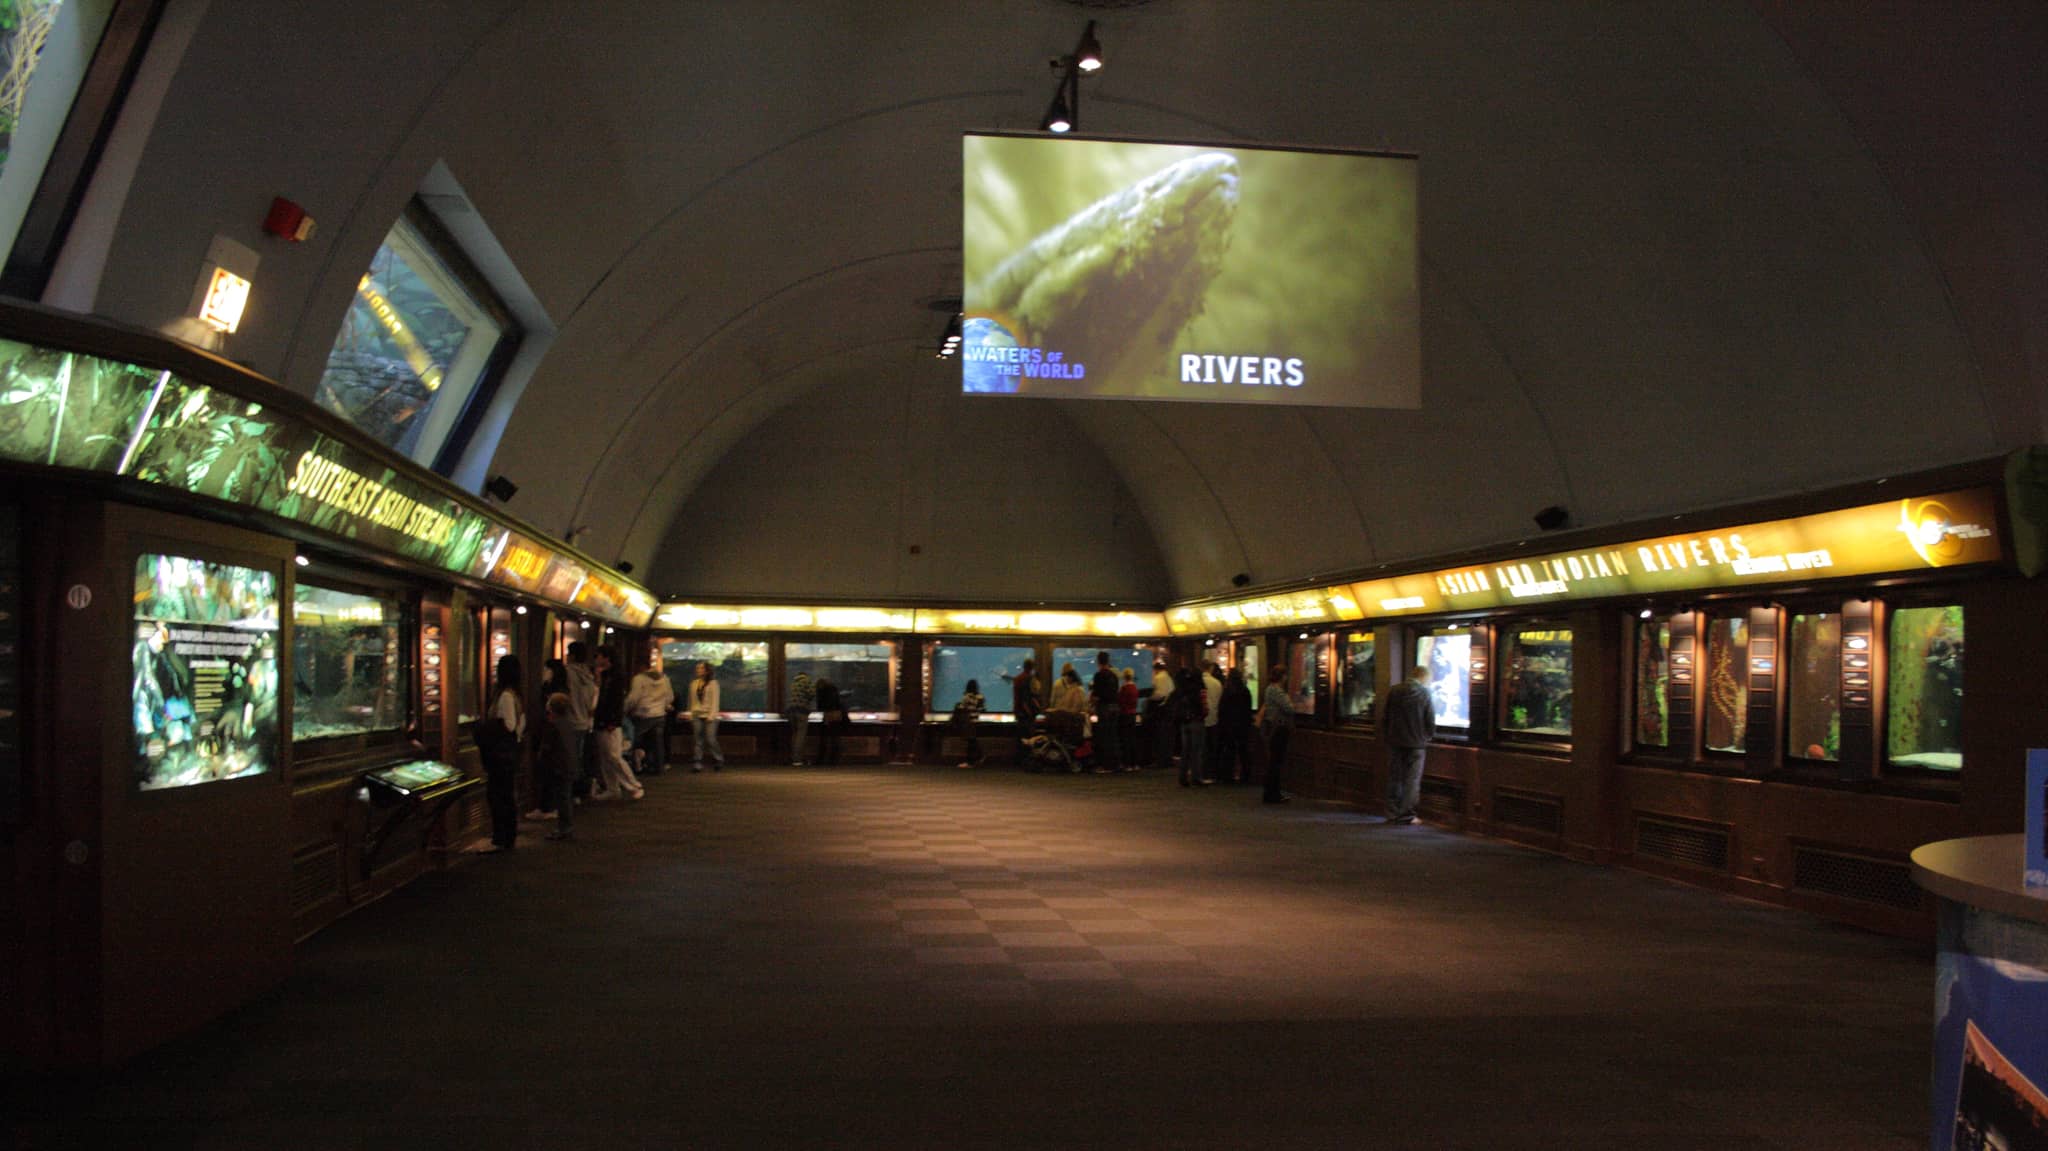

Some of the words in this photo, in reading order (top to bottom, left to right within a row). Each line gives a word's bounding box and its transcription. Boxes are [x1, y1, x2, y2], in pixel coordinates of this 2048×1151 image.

[968, 346, 1042, 364] WATERS
[1047, 352, 1063, 362] OF
[996, 364, 1020, 376] THE
[1025, 363, 1085, 379] WORLD
[1180, 353, 1304, 387] RIVERS
[287, 451, 383, 518] SOUTHEAST
[367, 487, 416, 531] ASIAN
[403, 503, 457, 547] STREAMS
[1436, 570, 1491, 596] ASIAN
[1496, 563, 1535, 588] AND
[1540, 550, 1629, 581] INDIAN
[1637, 533, 1750, 573] RIVERS
